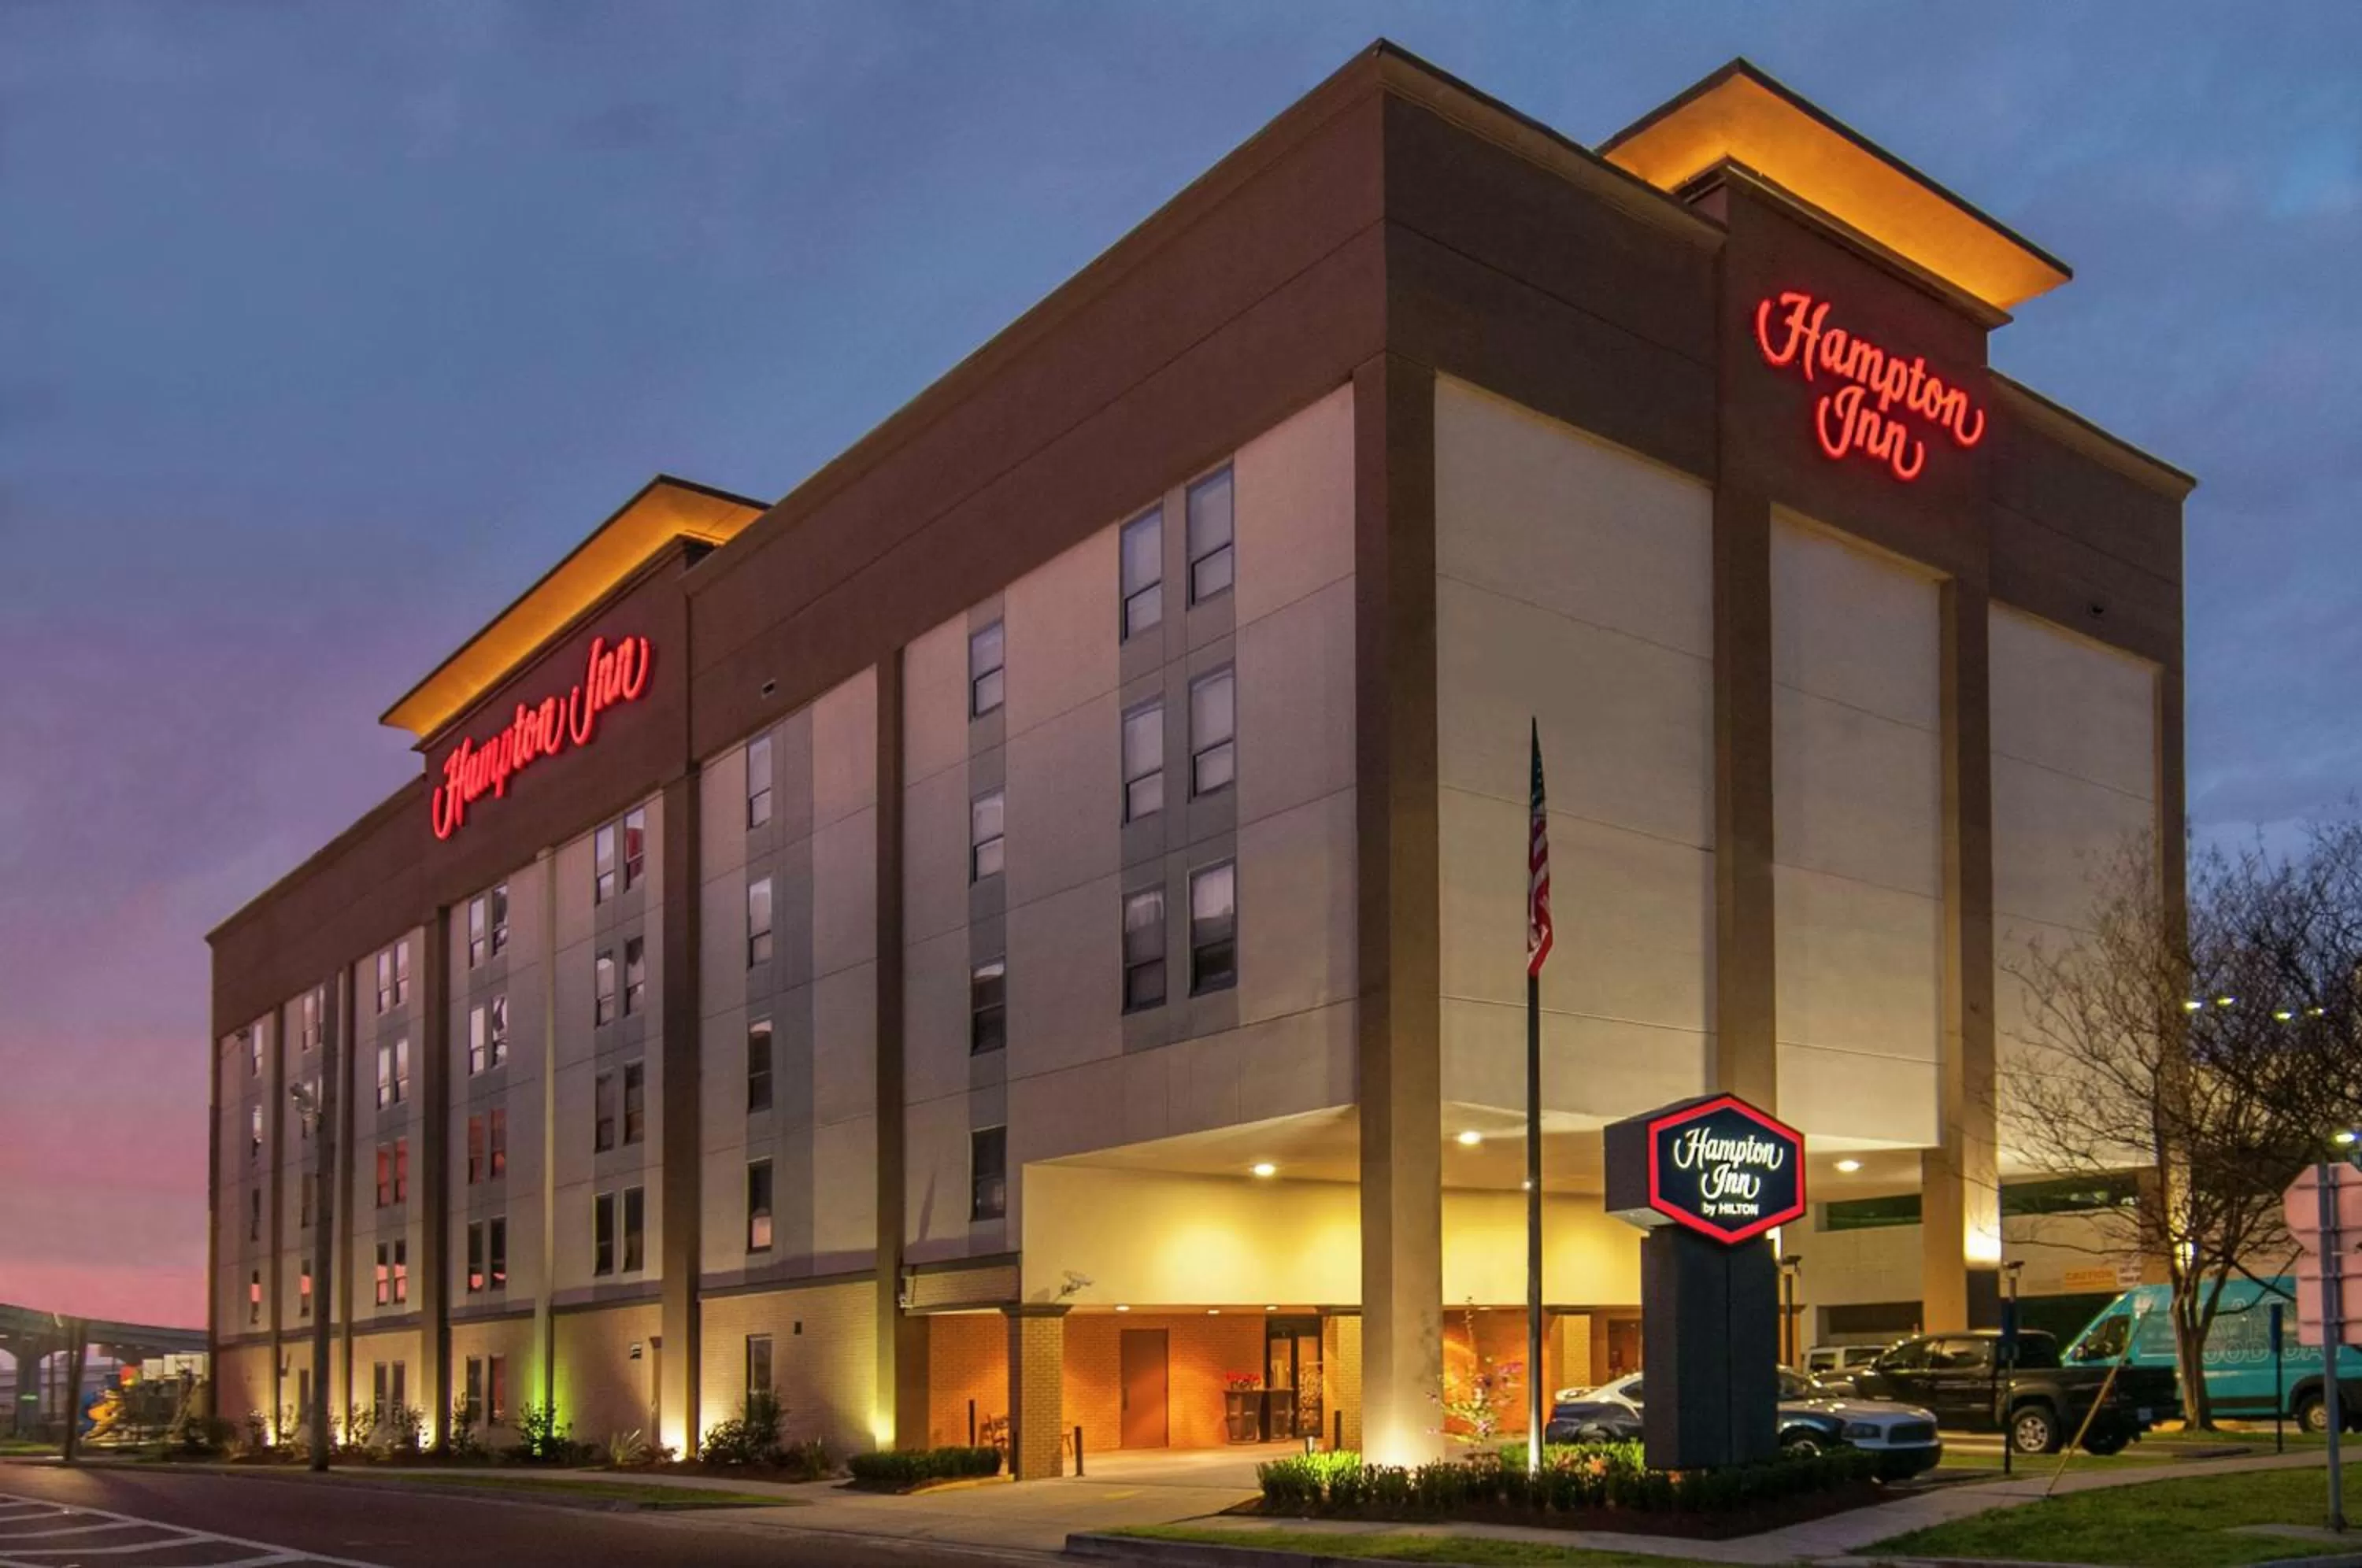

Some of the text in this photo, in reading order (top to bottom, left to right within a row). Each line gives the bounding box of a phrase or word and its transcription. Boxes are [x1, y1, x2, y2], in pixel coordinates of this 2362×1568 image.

[1756, 290, 1985, 446] Hampton
[1816, 384, 1925, 480] Inn
[433, 636, 649, 840] Hampton Inn
[1674, 1127, 1783, 1169] Hampton
[1701, 1163, 1760, 1199] Inn
[1701, 1201, 1758, 1217] by HILTON
